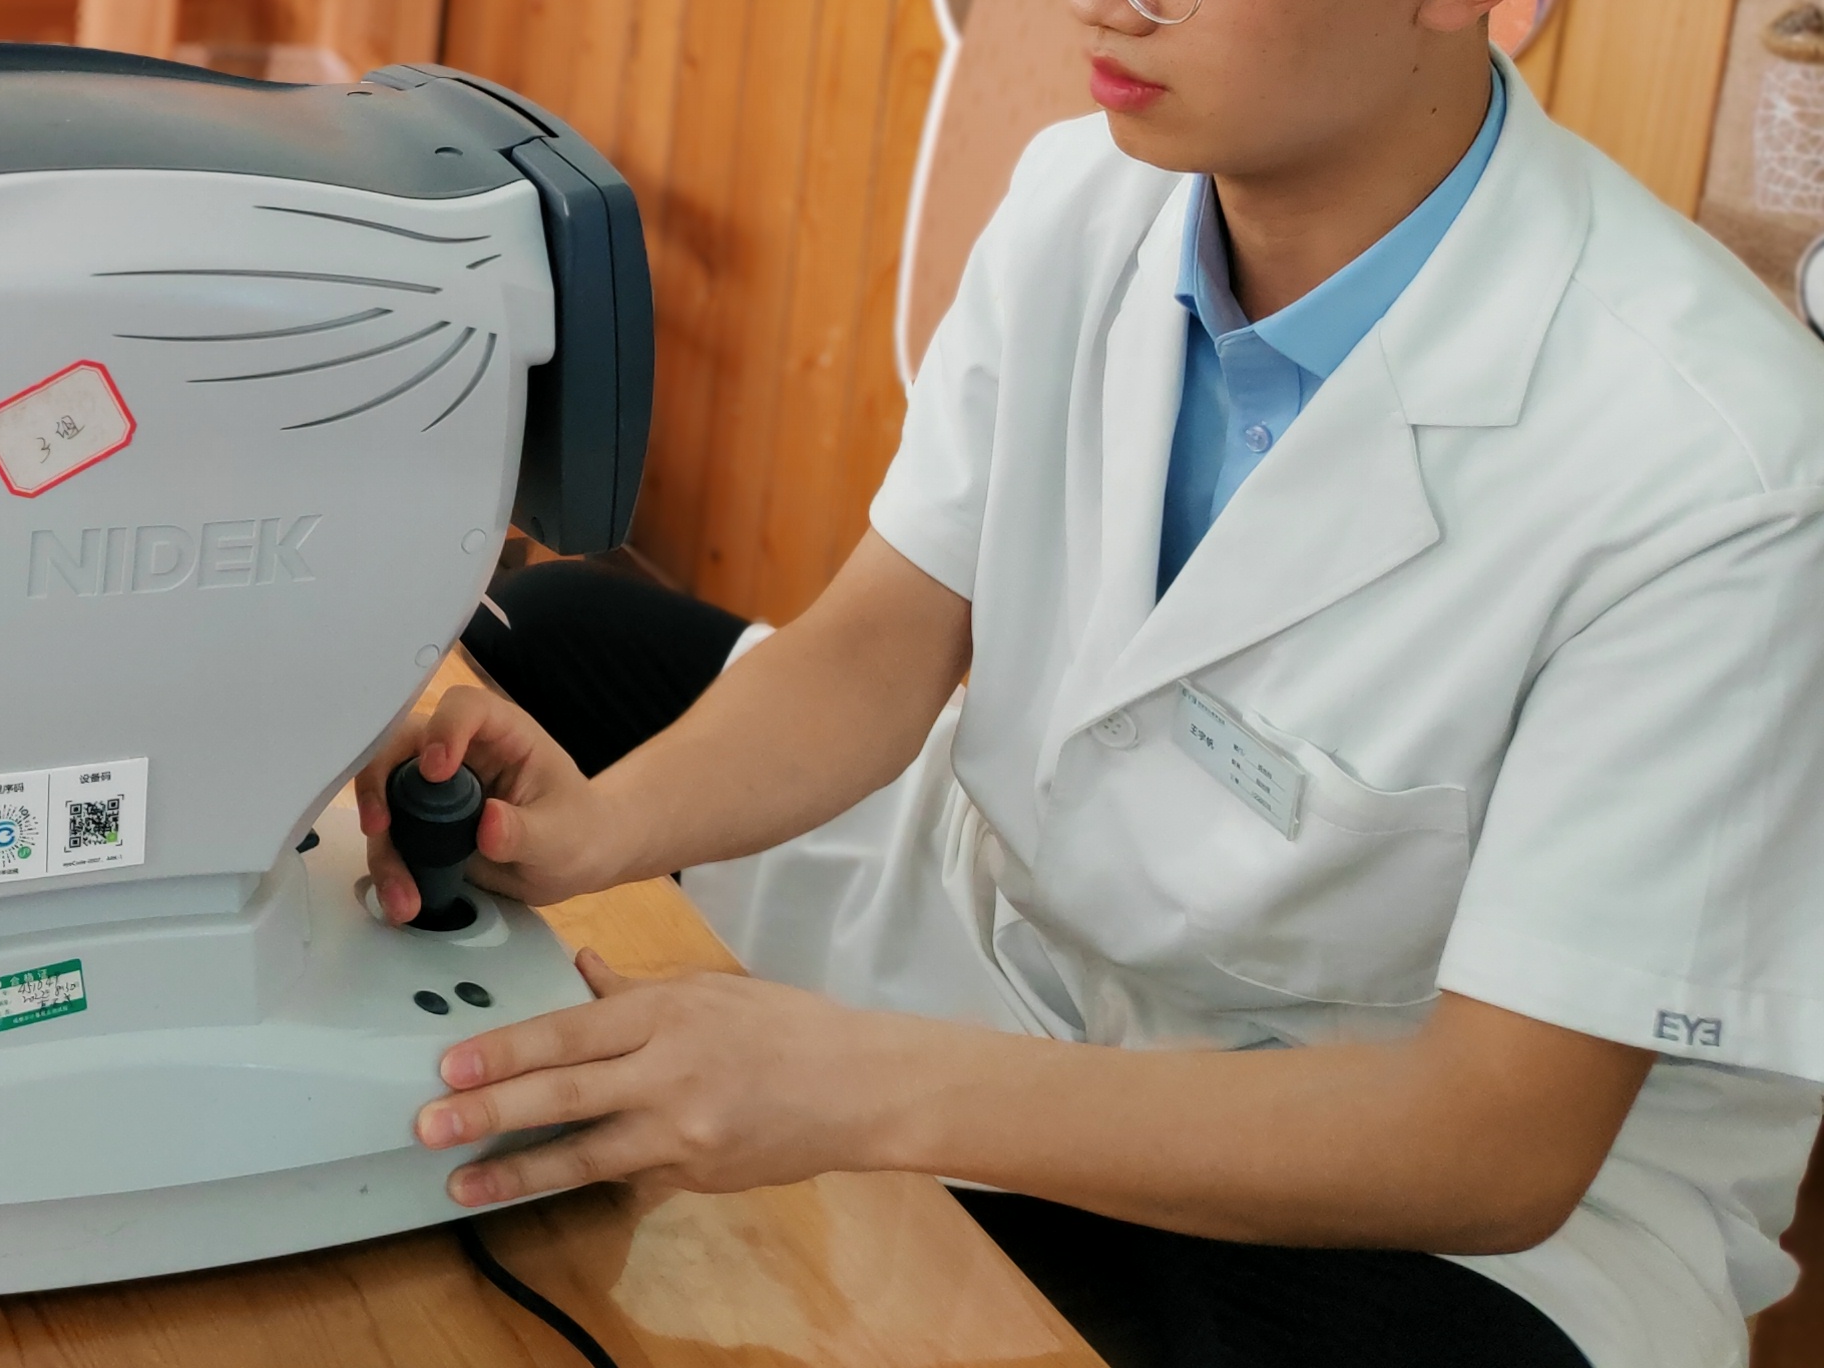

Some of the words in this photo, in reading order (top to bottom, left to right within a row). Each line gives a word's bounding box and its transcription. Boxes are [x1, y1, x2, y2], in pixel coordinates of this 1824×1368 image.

[26, 513, 323, 599] NIDEK
[79, 771, 112, 784] 设备码
[1653, 1008, 1723, 1047] EYE
